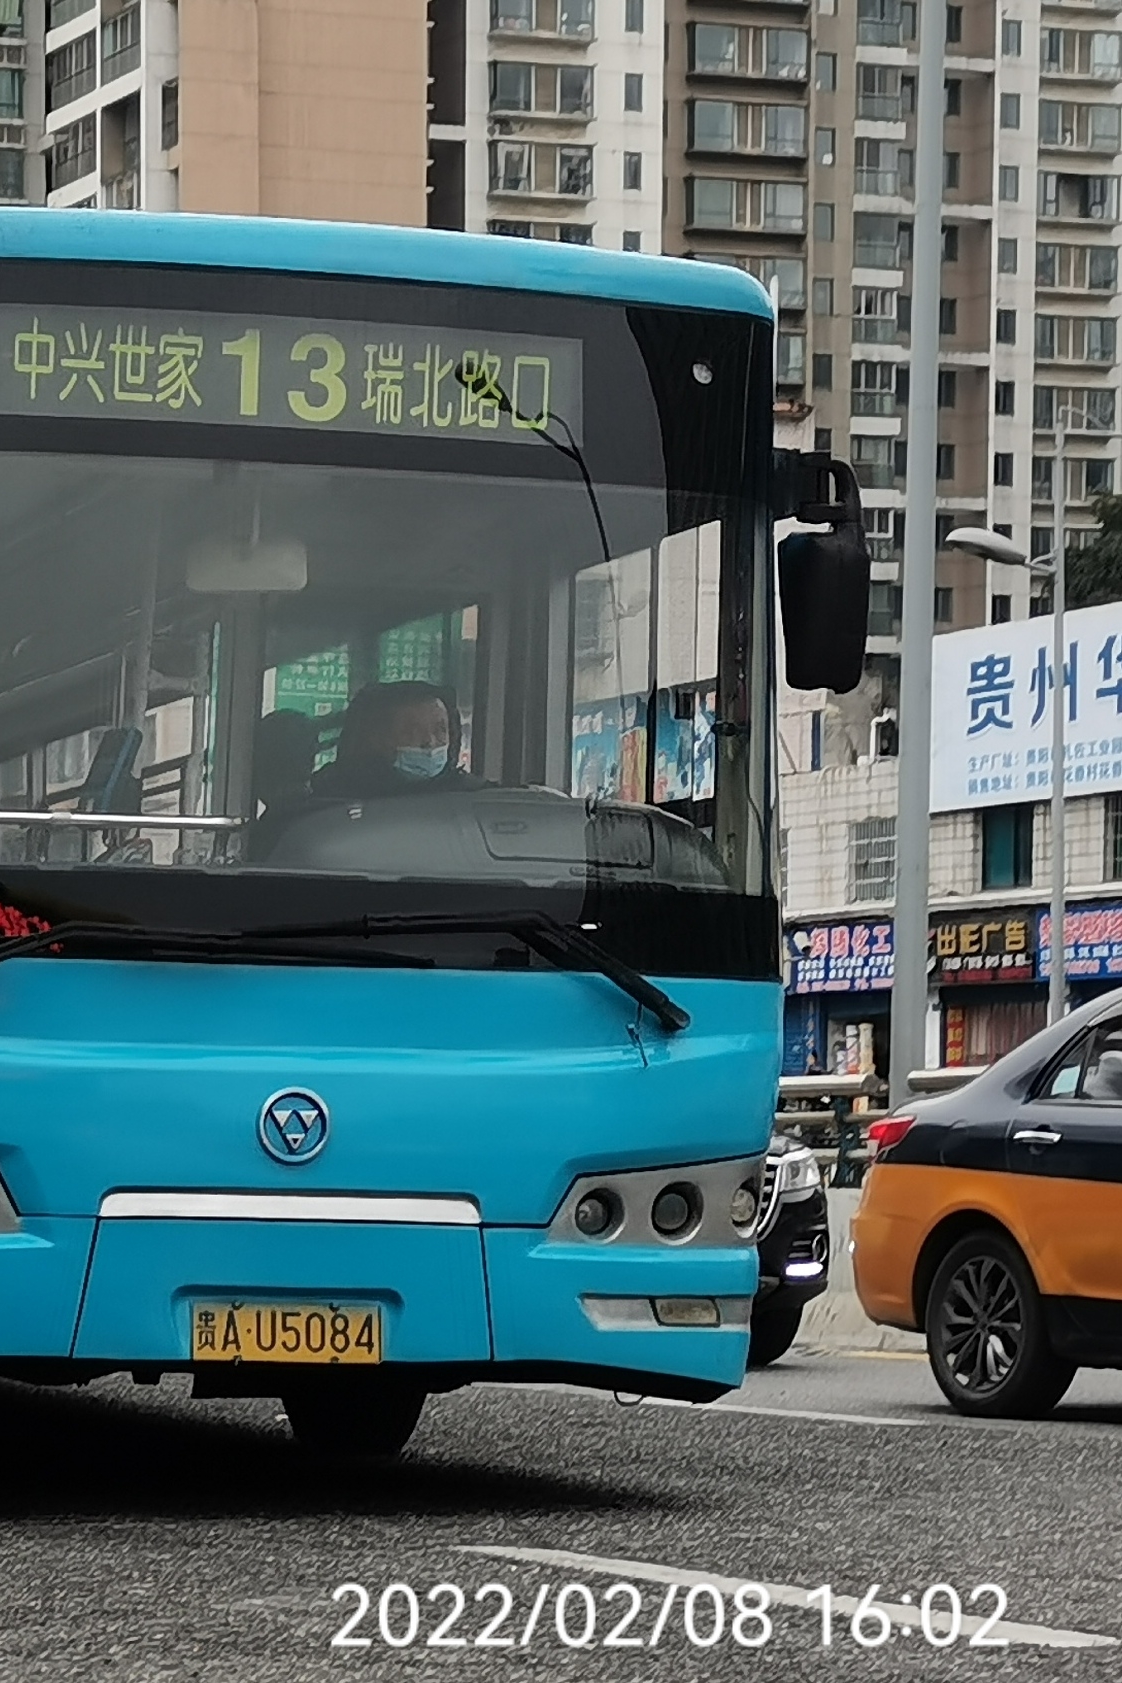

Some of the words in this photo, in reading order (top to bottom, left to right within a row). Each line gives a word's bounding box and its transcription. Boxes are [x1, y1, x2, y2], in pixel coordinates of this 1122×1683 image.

[13, 317, 204, 409] 中兴世家
[221, 328, 347, 423] 13
[361, 341, 551, 430] 瑞北路口
